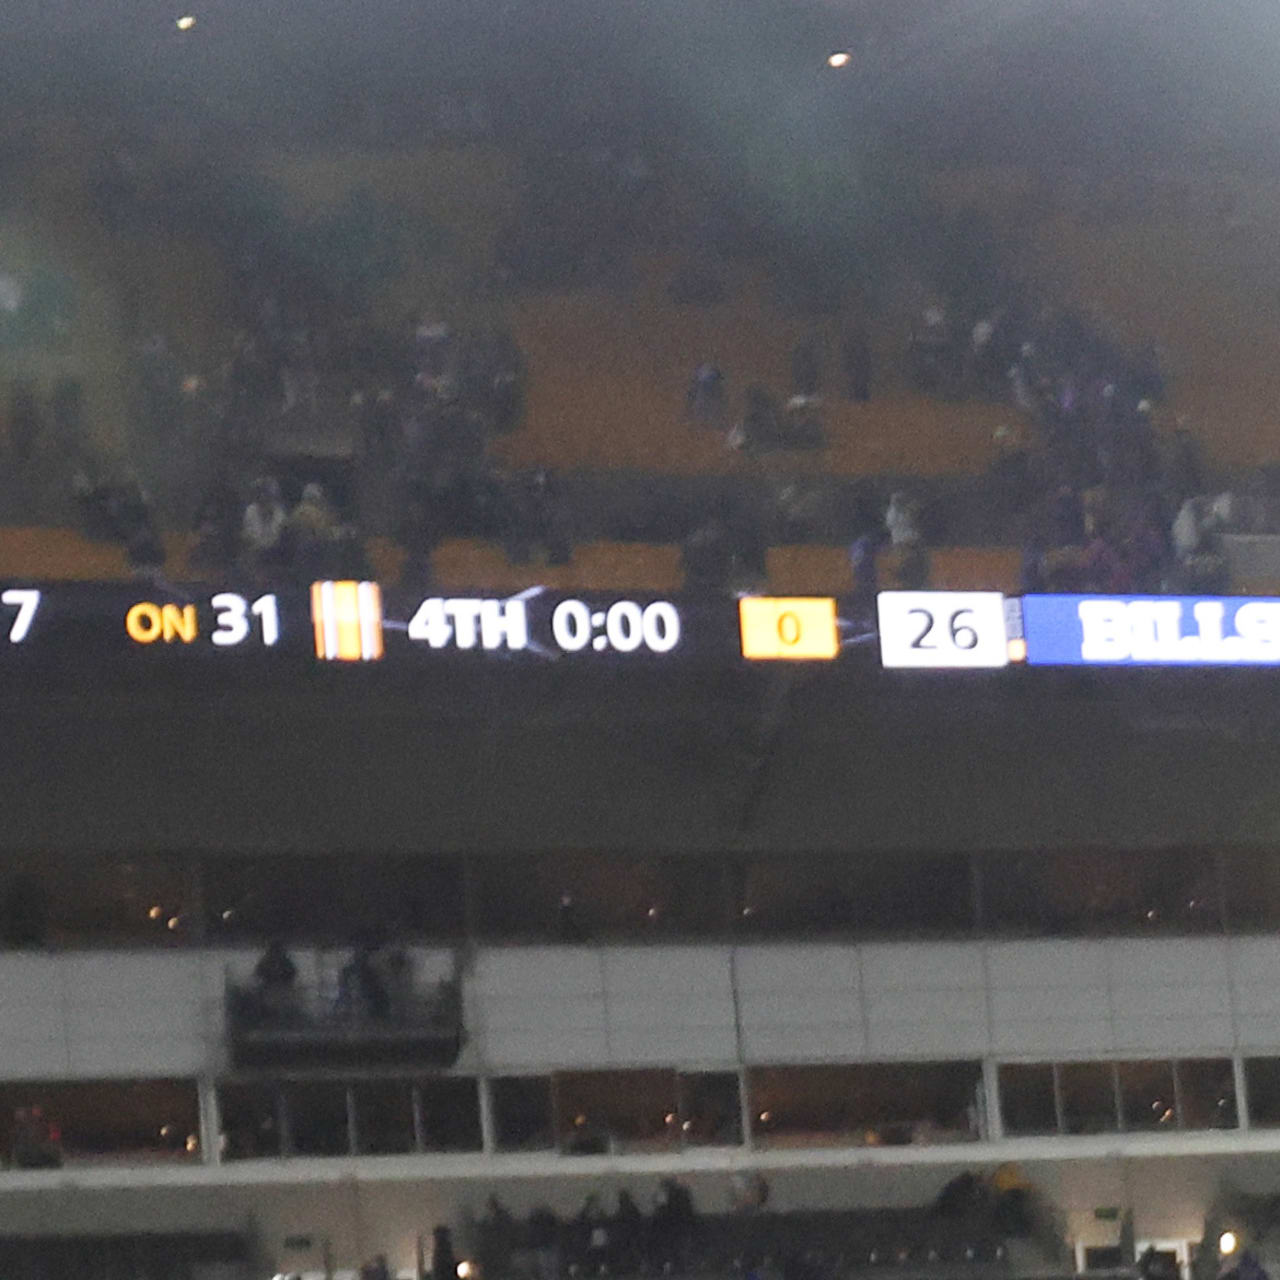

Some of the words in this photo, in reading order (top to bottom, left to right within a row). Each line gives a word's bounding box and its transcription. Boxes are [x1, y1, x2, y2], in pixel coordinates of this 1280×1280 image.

[2, 589, 40, 643] 7
[126, 602, 197, 643] ON
[210, 592, 278, 645] 31
[408, 598, 526, 649] 4TH
[552, 599, 679, 651] 0:00
[776, 611, 801, 646] 0
[906, 608, 980, 650] 26
